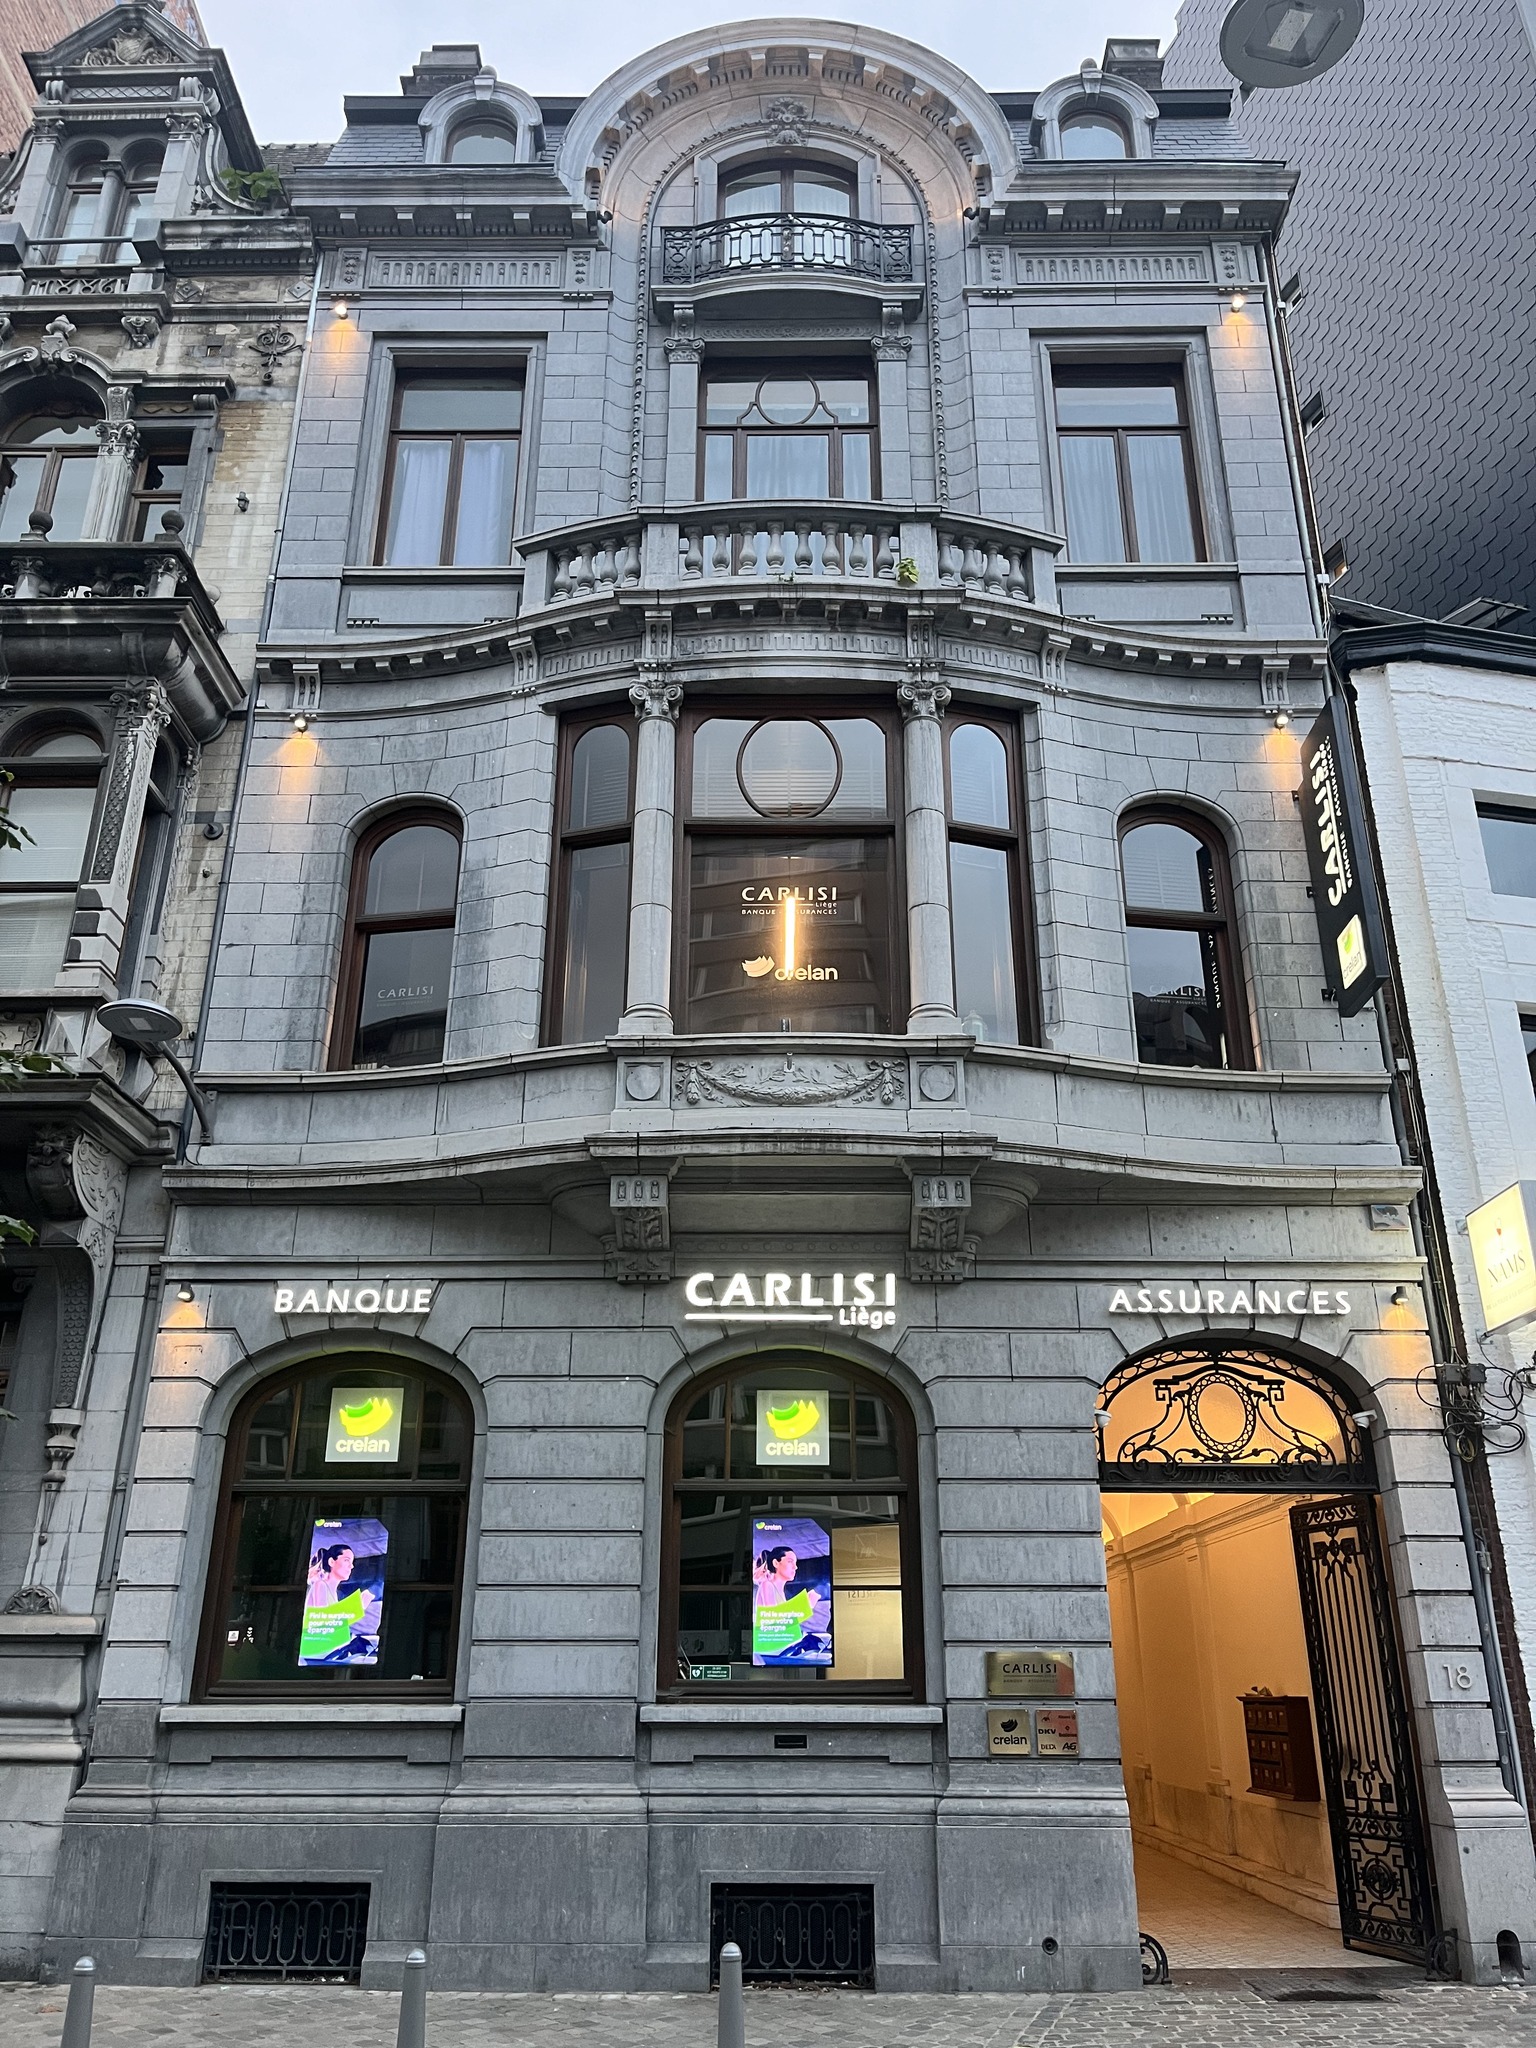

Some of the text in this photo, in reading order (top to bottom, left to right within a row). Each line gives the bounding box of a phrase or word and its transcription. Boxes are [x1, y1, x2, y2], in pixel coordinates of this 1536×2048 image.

[1309, 751, 1343, 906] CARLISI
[741, 886, 837, 901] CARLISI
[377, 985, 434, 999] CARLISI
[685, 1272, 896, 1307] CARLISI
[273, 1288, 432, 1314] BANQUE
[1108, 1288, 1352, 1315] ASSURANCES
[839, 1306, 896, 1330] Liège
[335, 1436, 391, 1453] crelan
[765, 1439, 820, 1456] crelan
[1002, 1663, 1057, 1674] CARLISI
[1442, 1664, 1473, 1690] 18
[993, 1734, 1028, 1745] crelan
[1061, 1742, 1077, 1751] AG
